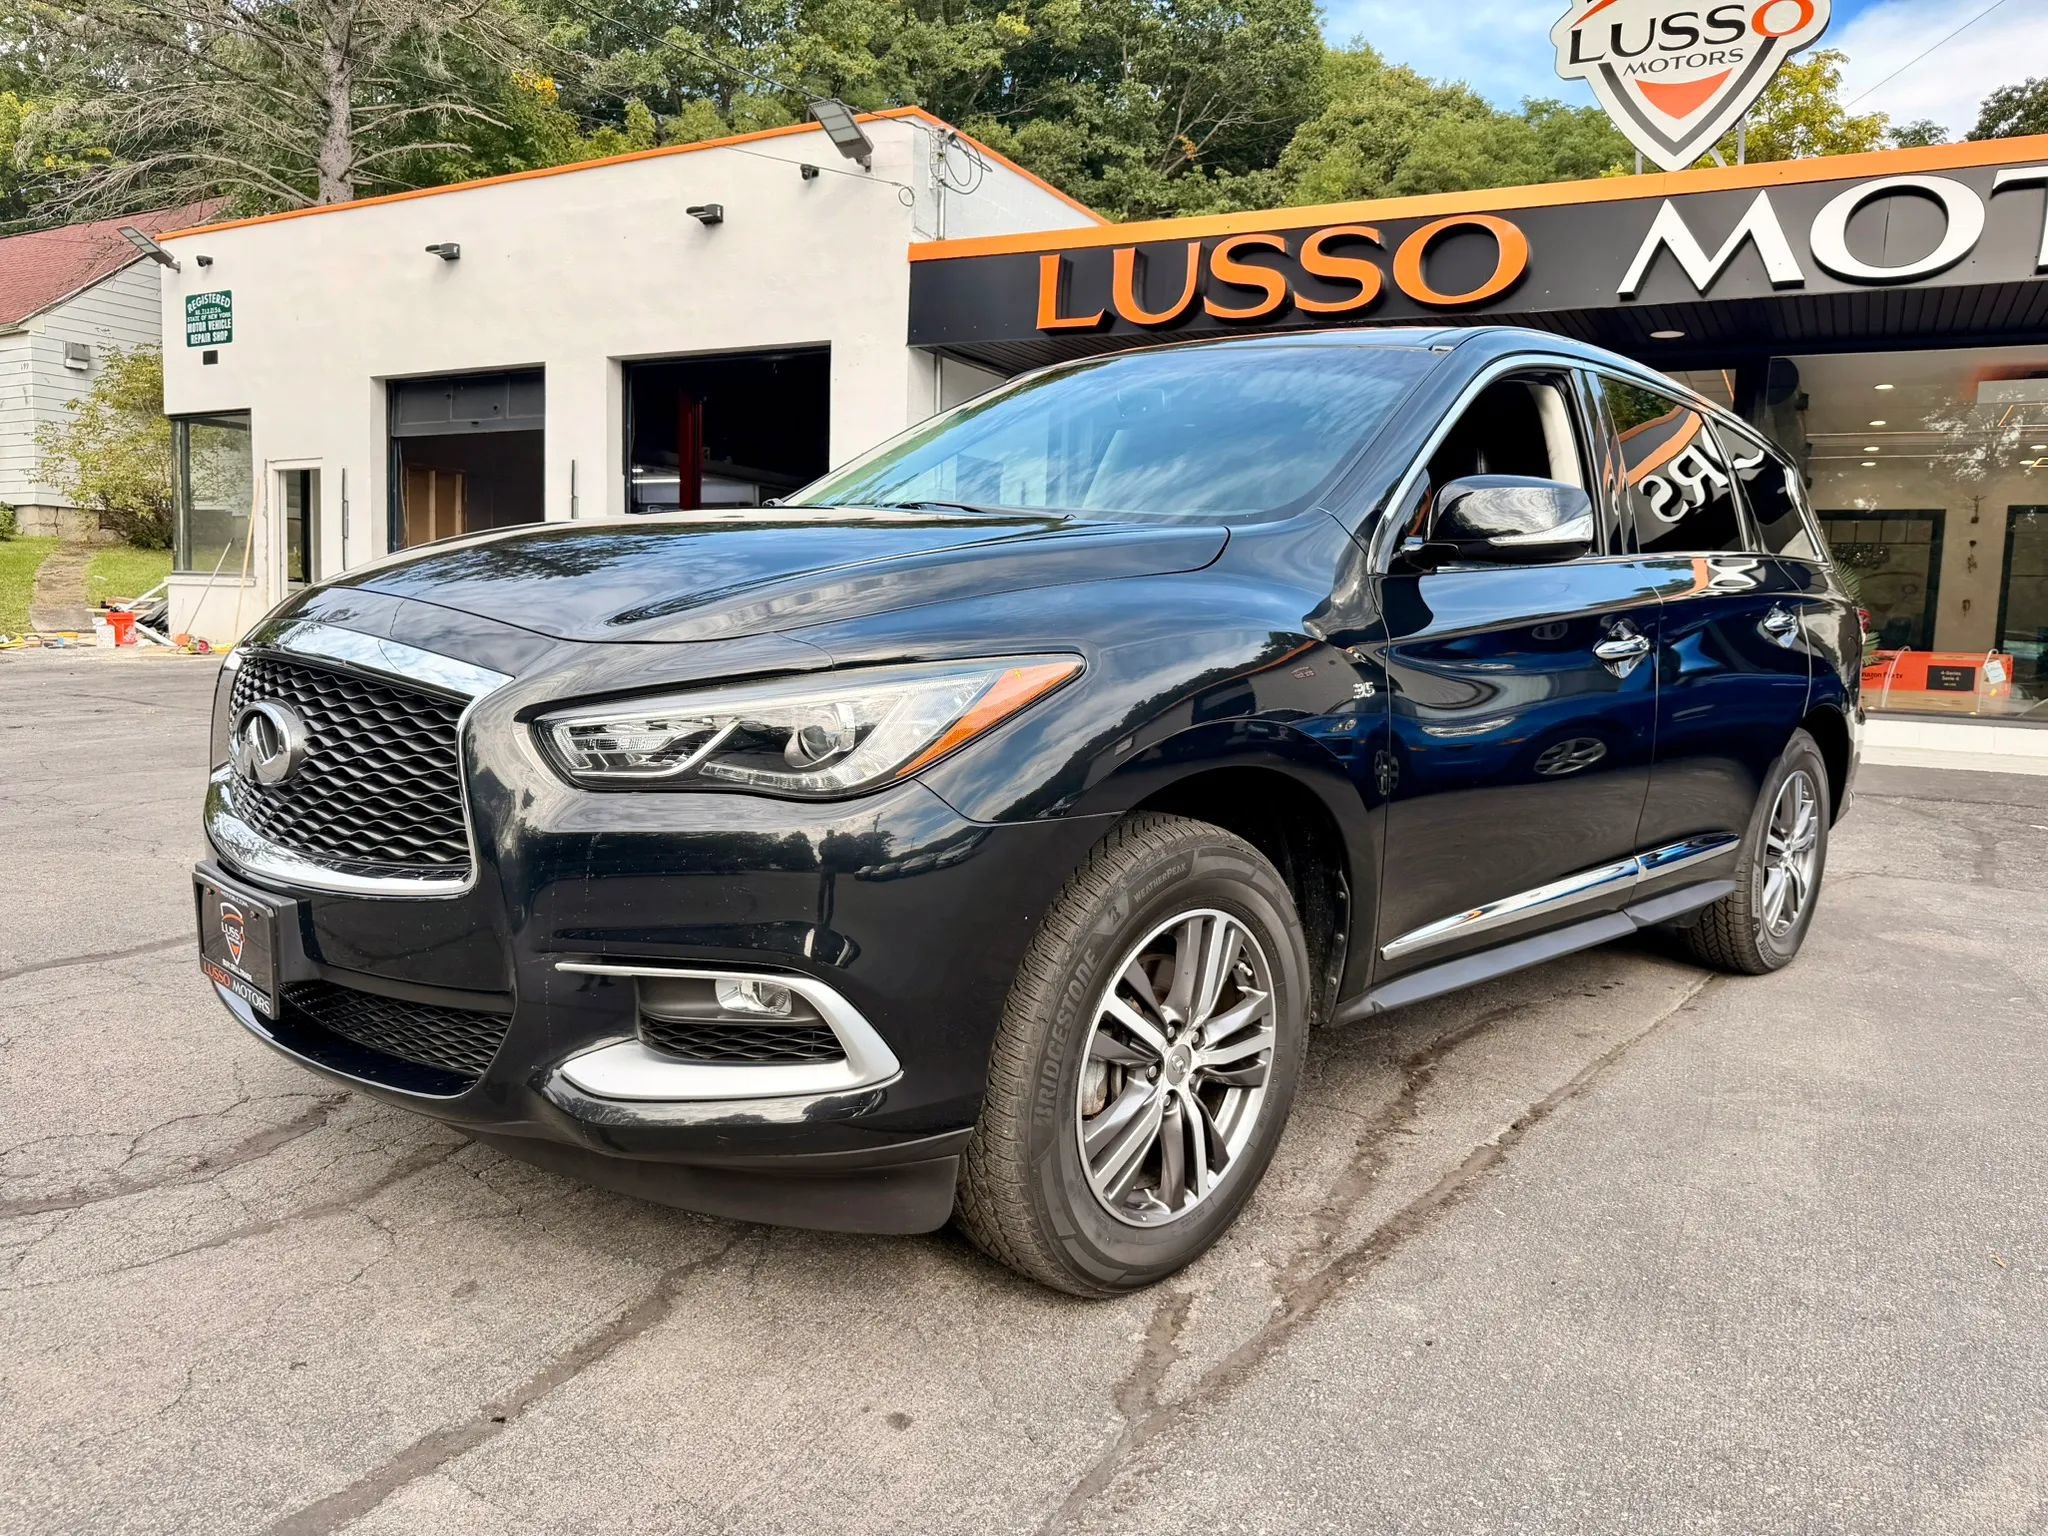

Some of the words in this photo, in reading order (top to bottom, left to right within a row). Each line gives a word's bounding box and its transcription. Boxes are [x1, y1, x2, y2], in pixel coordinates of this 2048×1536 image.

[1569, 0, 1815, 65] LUSSO
[1623, 48, 1744, 77] MOTORS
[1035, 214, 1530, 331] LUSSO
[187, 293, 231, 313] REGISTERED
[187, 322, 207, 333] MOTOR
[208, 319, 231, 330] VEHICLE
[191, 333, 211, 344] REPAIR
[212, 330, 228, 342] SHOP
[1133, 862, 1187, 903] WEATHERPEAK
[203, 961, 231, 987] LUSSO
[232, 980, 270, 1014] MOTORS
[1033, 948, 1099, 1127] BRIDGESTONE
